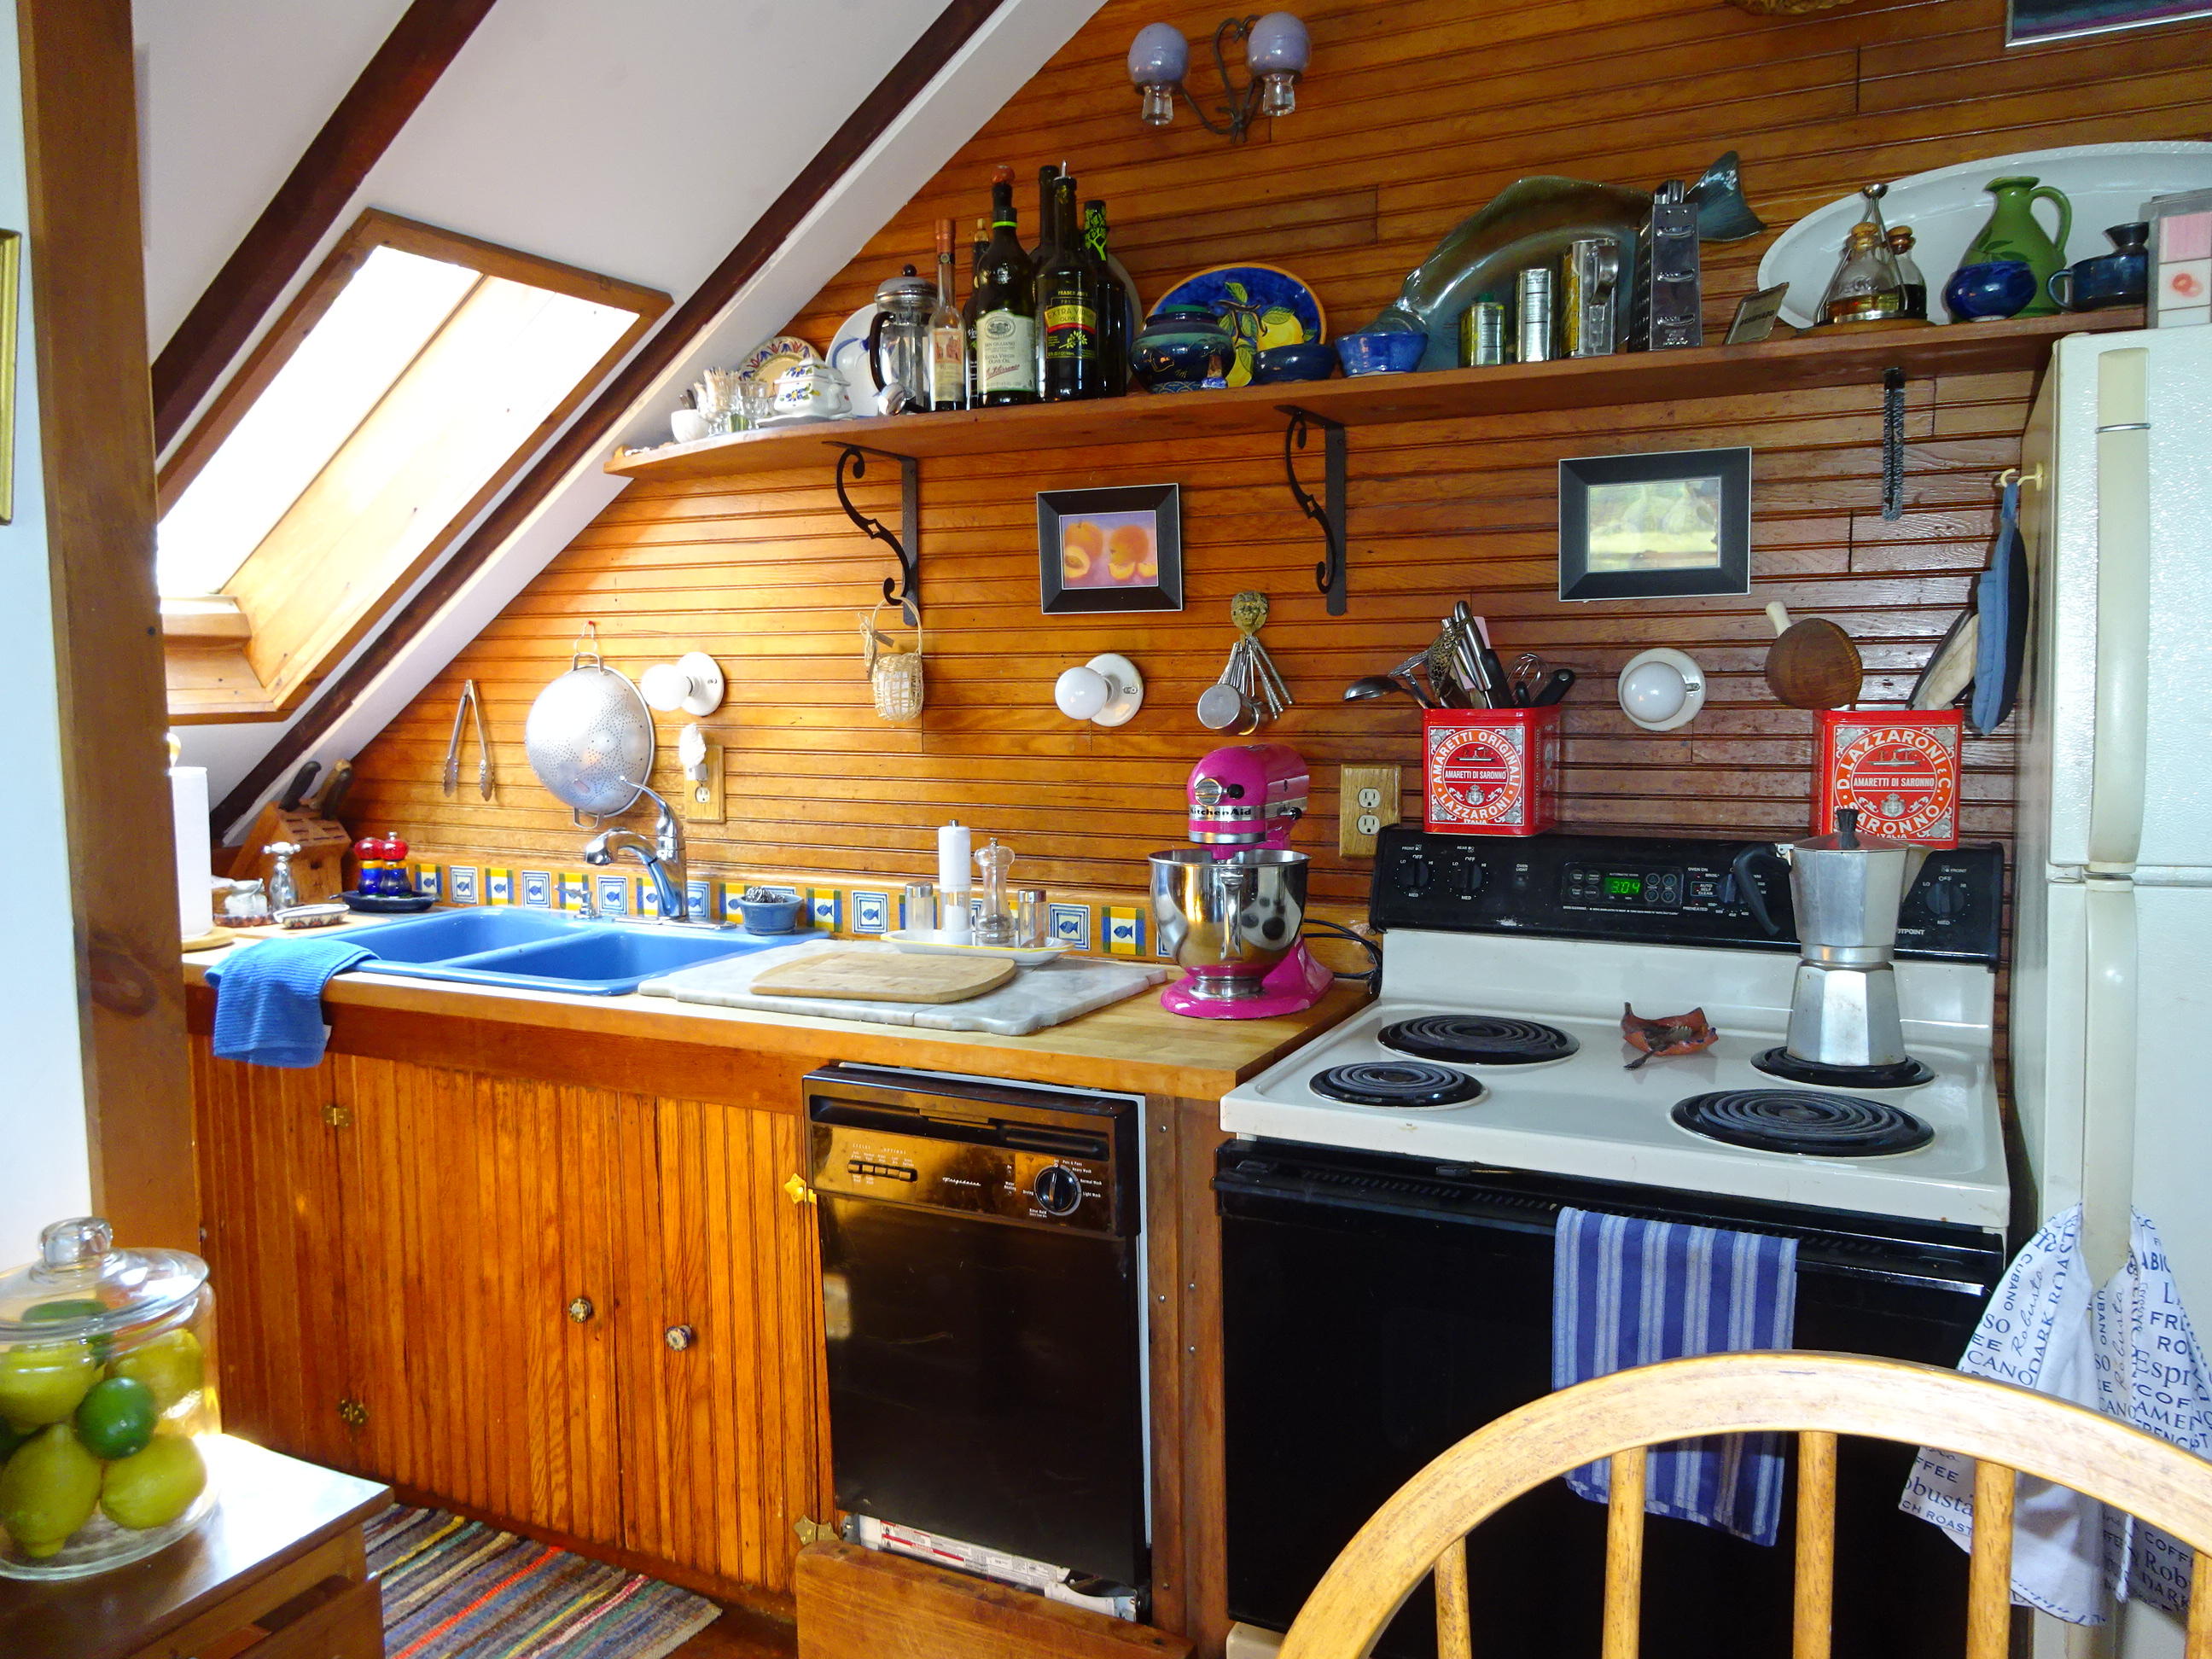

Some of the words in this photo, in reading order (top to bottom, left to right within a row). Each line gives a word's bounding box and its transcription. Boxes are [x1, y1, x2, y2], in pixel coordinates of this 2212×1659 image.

[1433, 731, 1474, 784] AMARETTI
[1478, 731, 1519, 787] ORIGINALI
[1444, 770, 1471, 779] AMARETTI
[1472, 770, 1479, 779] DI
[1479, 770, 1506, 780] SARONNO
[1853, 777, 1889, 787] AMARETTI
[1890, 777, 1900, 787] DI
[1901, 777, 1935, 787] SARONNO
[1190, 806, 1252, 816] KitchenAid
[1439, 795, 1511, 820] LAZZARONI
[2003, 1253, 2034, 1312] CUBANO
